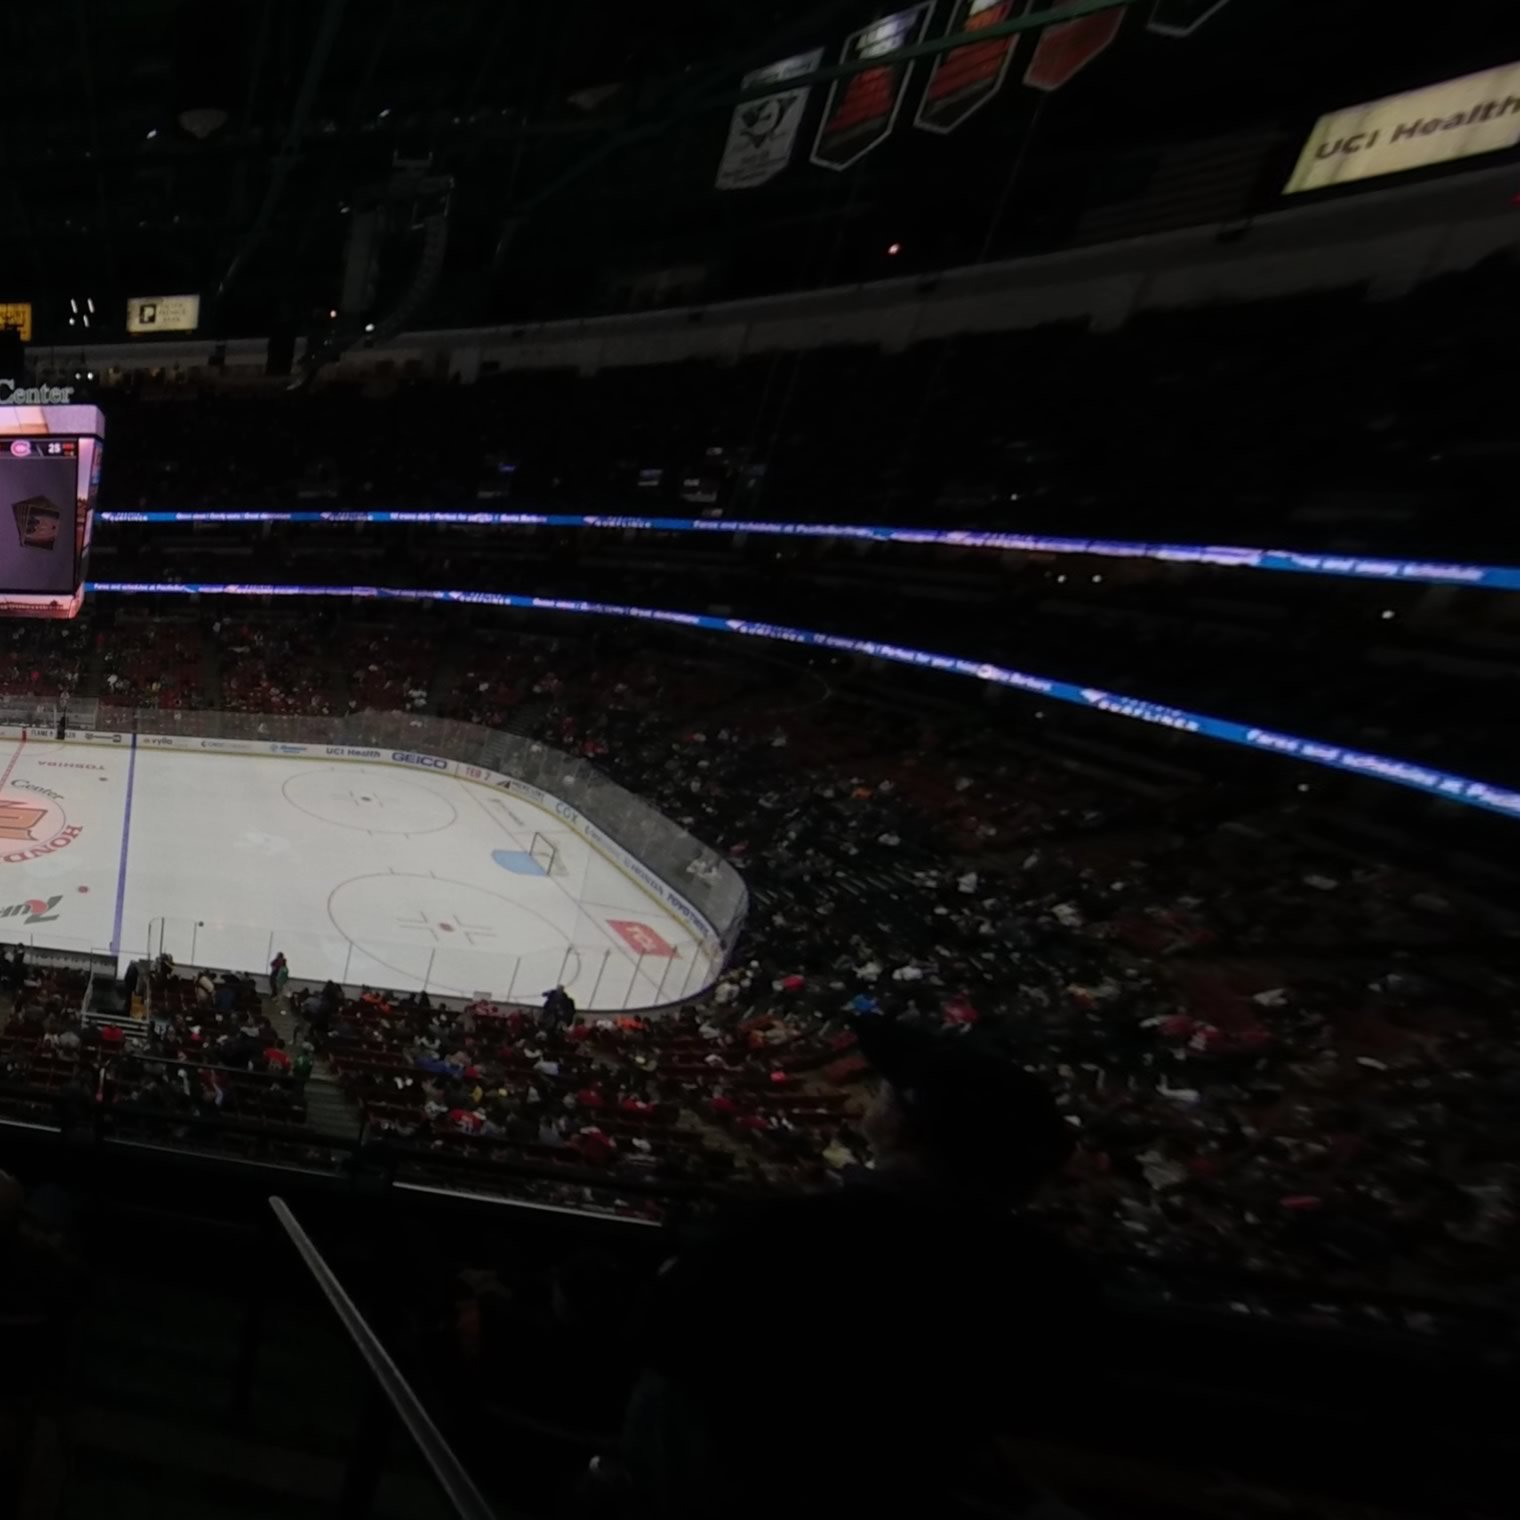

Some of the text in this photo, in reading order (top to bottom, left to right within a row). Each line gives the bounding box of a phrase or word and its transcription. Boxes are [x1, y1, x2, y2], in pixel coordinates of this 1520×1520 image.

[1314, 129, 1380, 161] UCI
[326, 747, 381, 758] UCI Health
[391, 751, 448, 770] GEICO
[38, 759, 106, 772] TOSHIBA
[10, 777, 64, 802] Center
[555, 801, 578, 826] COX
